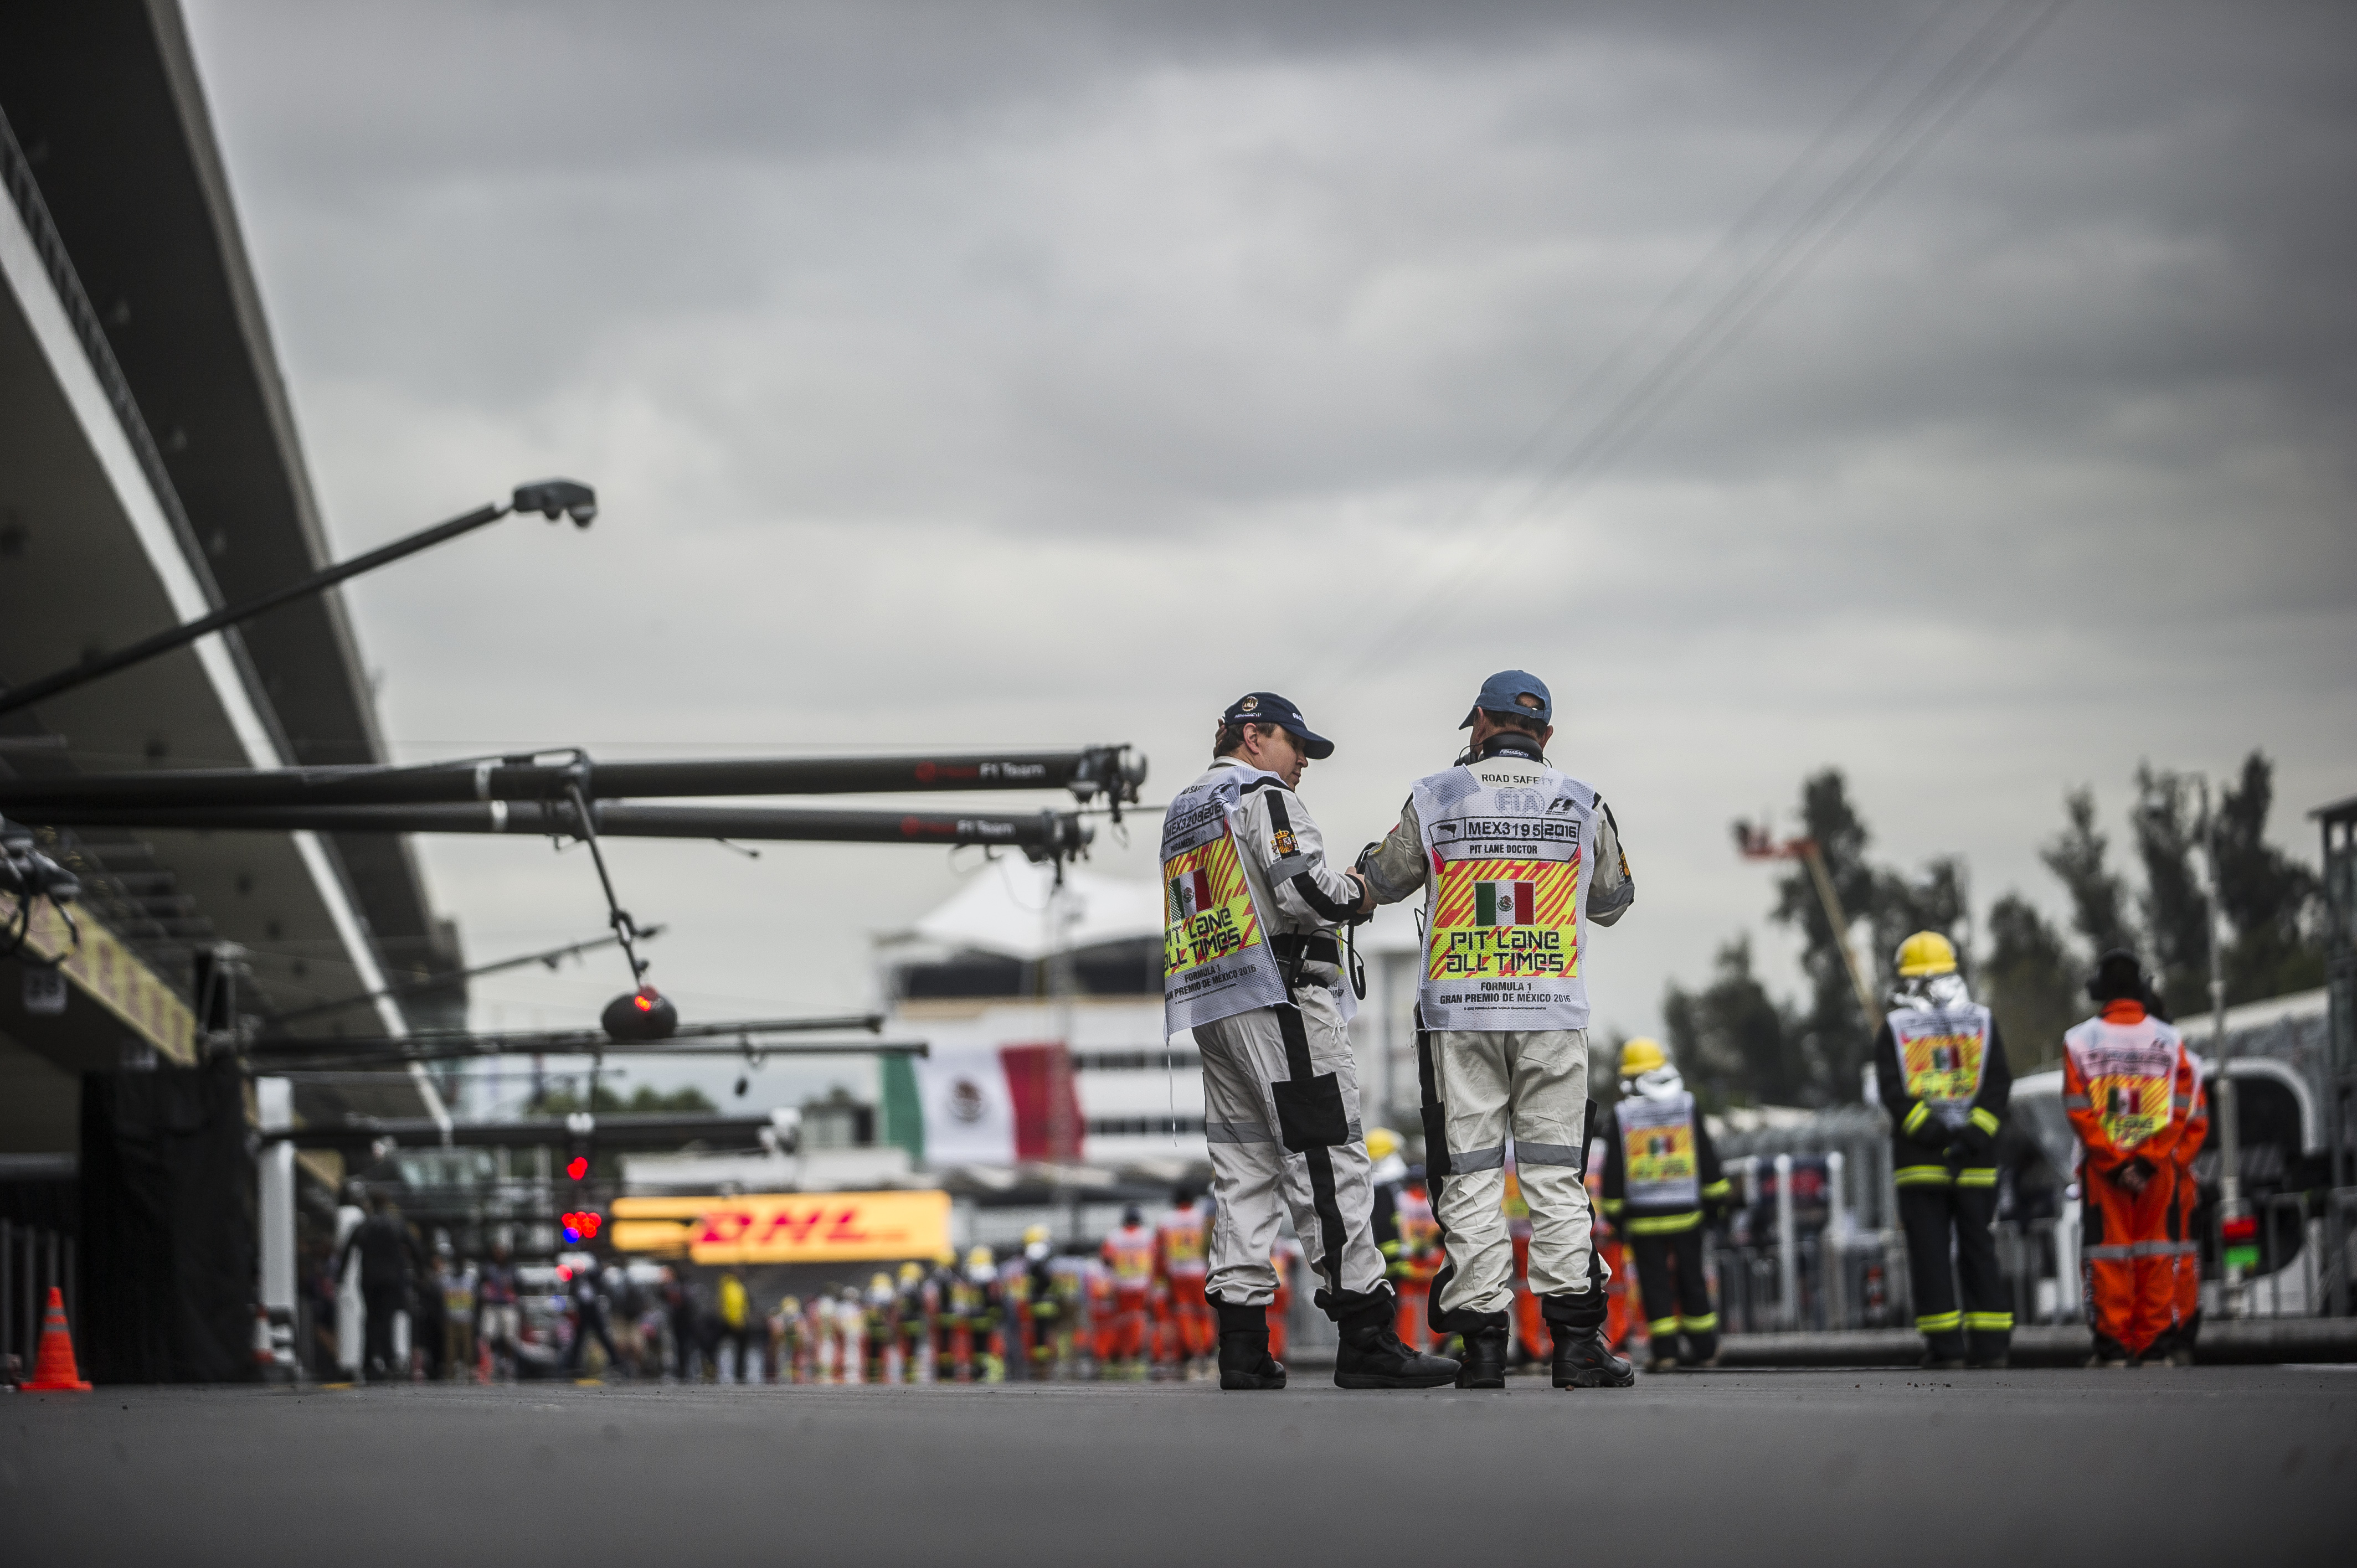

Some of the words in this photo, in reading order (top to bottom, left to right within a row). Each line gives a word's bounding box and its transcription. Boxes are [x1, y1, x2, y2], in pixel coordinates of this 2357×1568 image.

[1481, 774, 1509, 782] ROAD
[1166, 811, 1202, 838] MEX3208
[1468, 821, 1541, 837] MEX3195
[1544, 823, 1577, 838] 2016
[1171, 835, 1195, 853] PARAMEDIC
[1469, 844, 1481, 854] PIT
[1484, 844, 1504, 854] LANE
[1506, 844, 1537, 854] DOCTOR
[1450, 931, 1489, 951] PIT
[1174, 982, 1201, 997] PREMIO
[1202, 978, 1212, 988] DE
[1238, 963, 1257, 977] 2016
[1184, 965, 1216, 983] FORMULA
[1217, 963, 1221, 972] 1
[1481, 982, 1524, 991] FORMULA
[1527, 982, 1531, 991] 1
[1440, 994, 1462, 1004] GRAN
[1465, 993, 1499, 1003] PREMIO
[1502, 993, 1514, 1002] DE
[1517, 991, 1551, 1002] MÉXICO
[1553, 994, 1571, 1003] 2016
[696, 1207, 867, 1246] DHL
